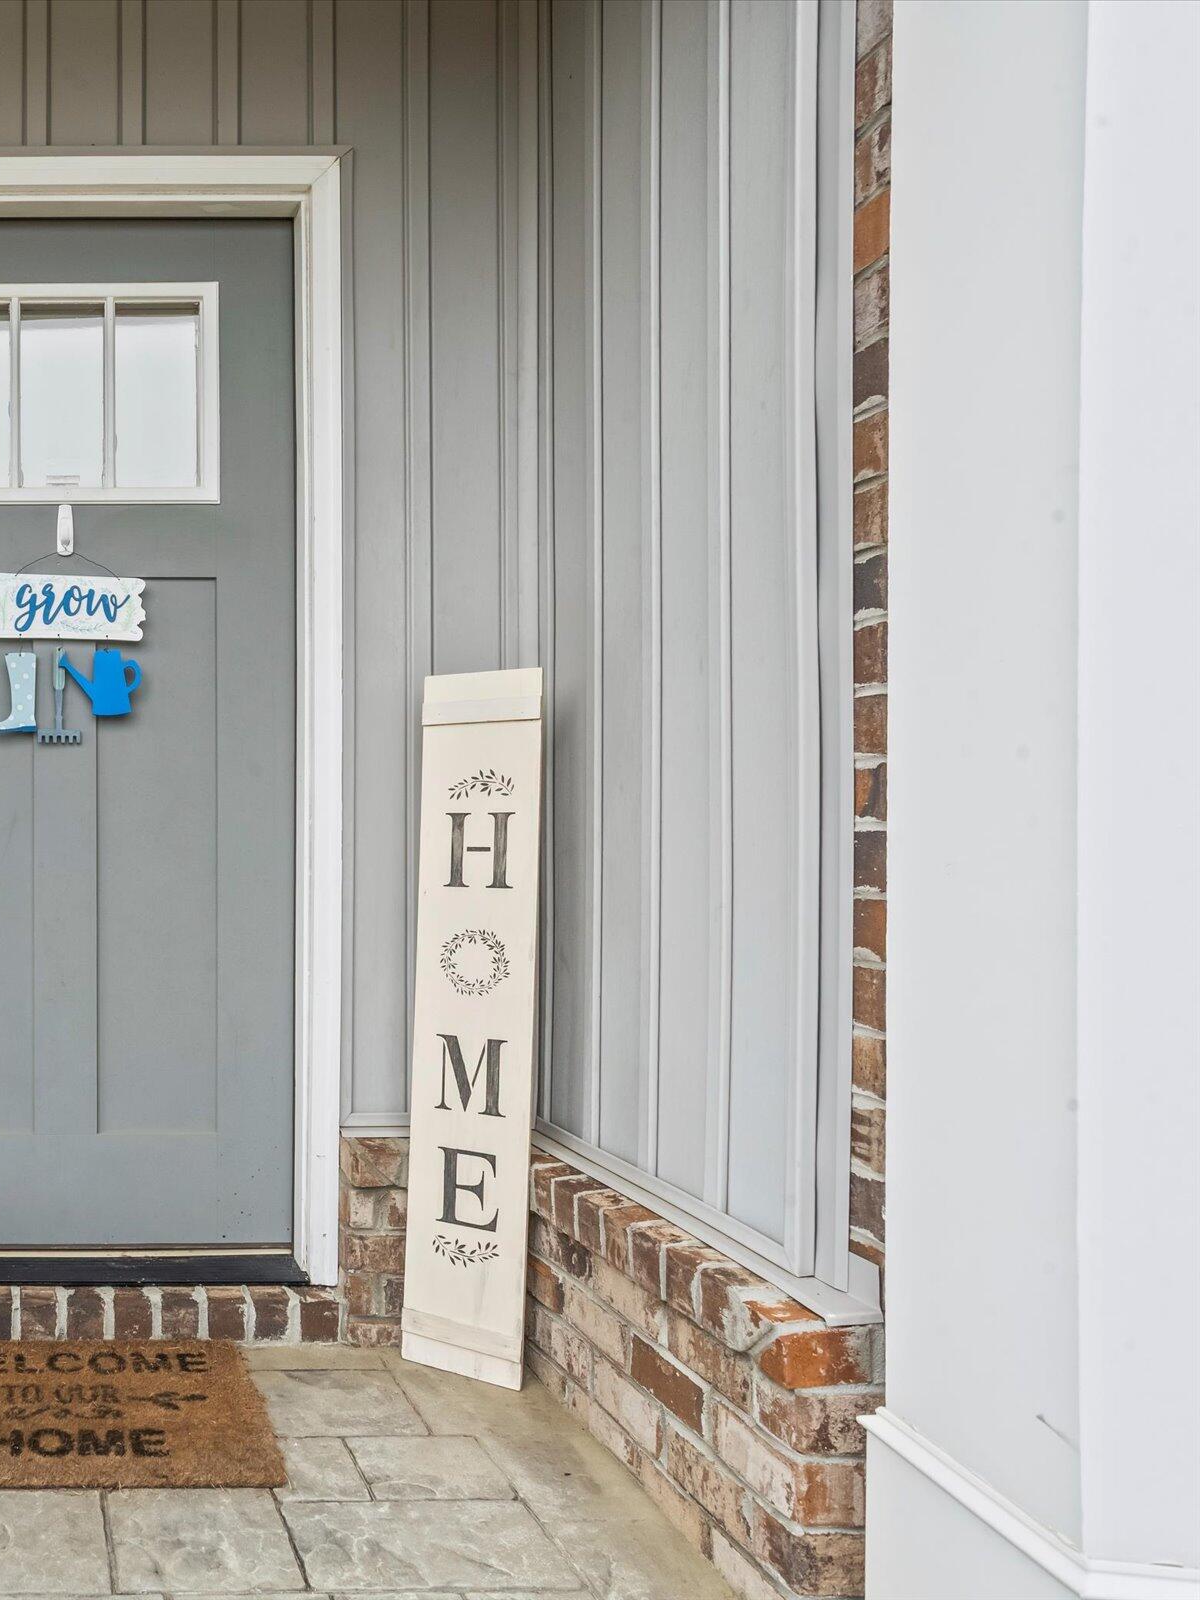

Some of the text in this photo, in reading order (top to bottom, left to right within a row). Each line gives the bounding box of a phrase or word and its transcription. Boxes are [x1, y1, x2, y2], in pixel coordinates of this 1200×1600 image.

[14, 582, 131, 632] grow
[0, 1383, 121, 1403] TO OUR
